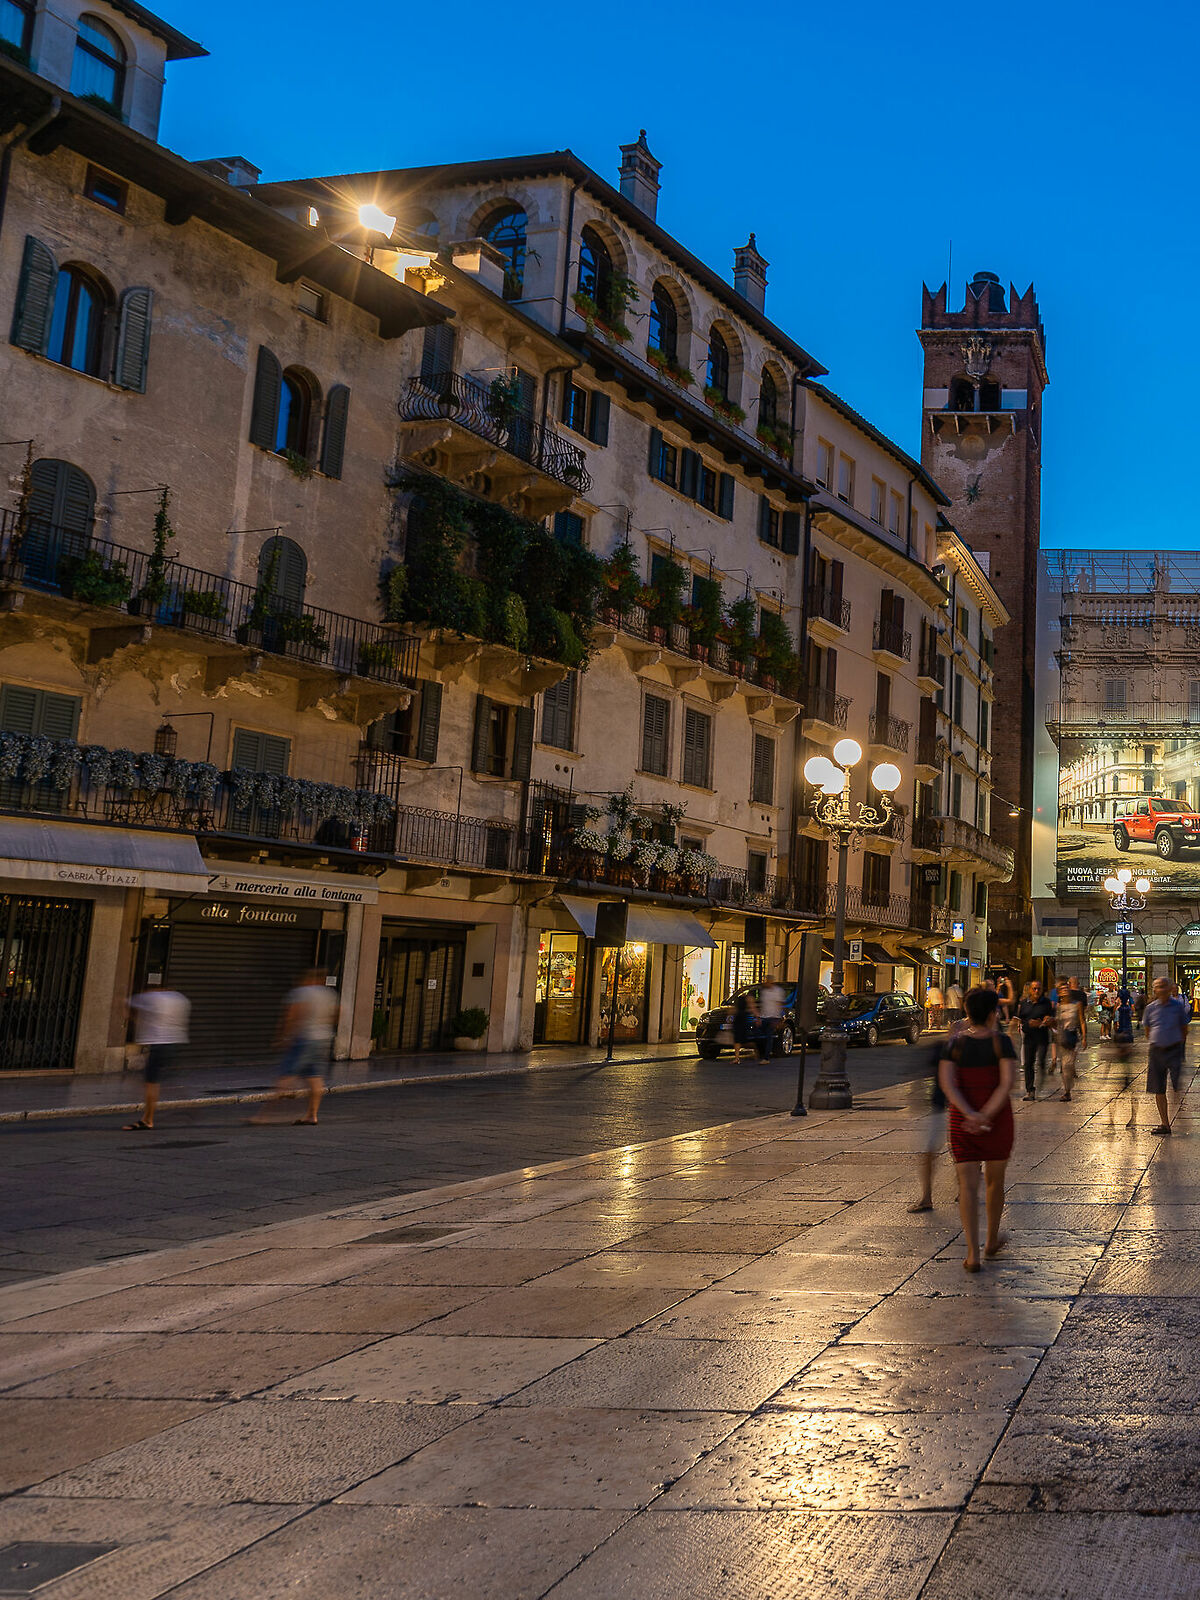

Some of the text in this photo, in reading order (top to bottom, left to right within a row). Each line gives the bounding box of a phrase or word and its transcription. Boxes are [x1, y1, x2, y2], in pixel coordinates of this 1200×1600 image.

[1067, 867, 1093, 875] NUOVA
[234, 882, 363, 902] merceria alla fontana
[201, 903, 298, 923] alla fontana
